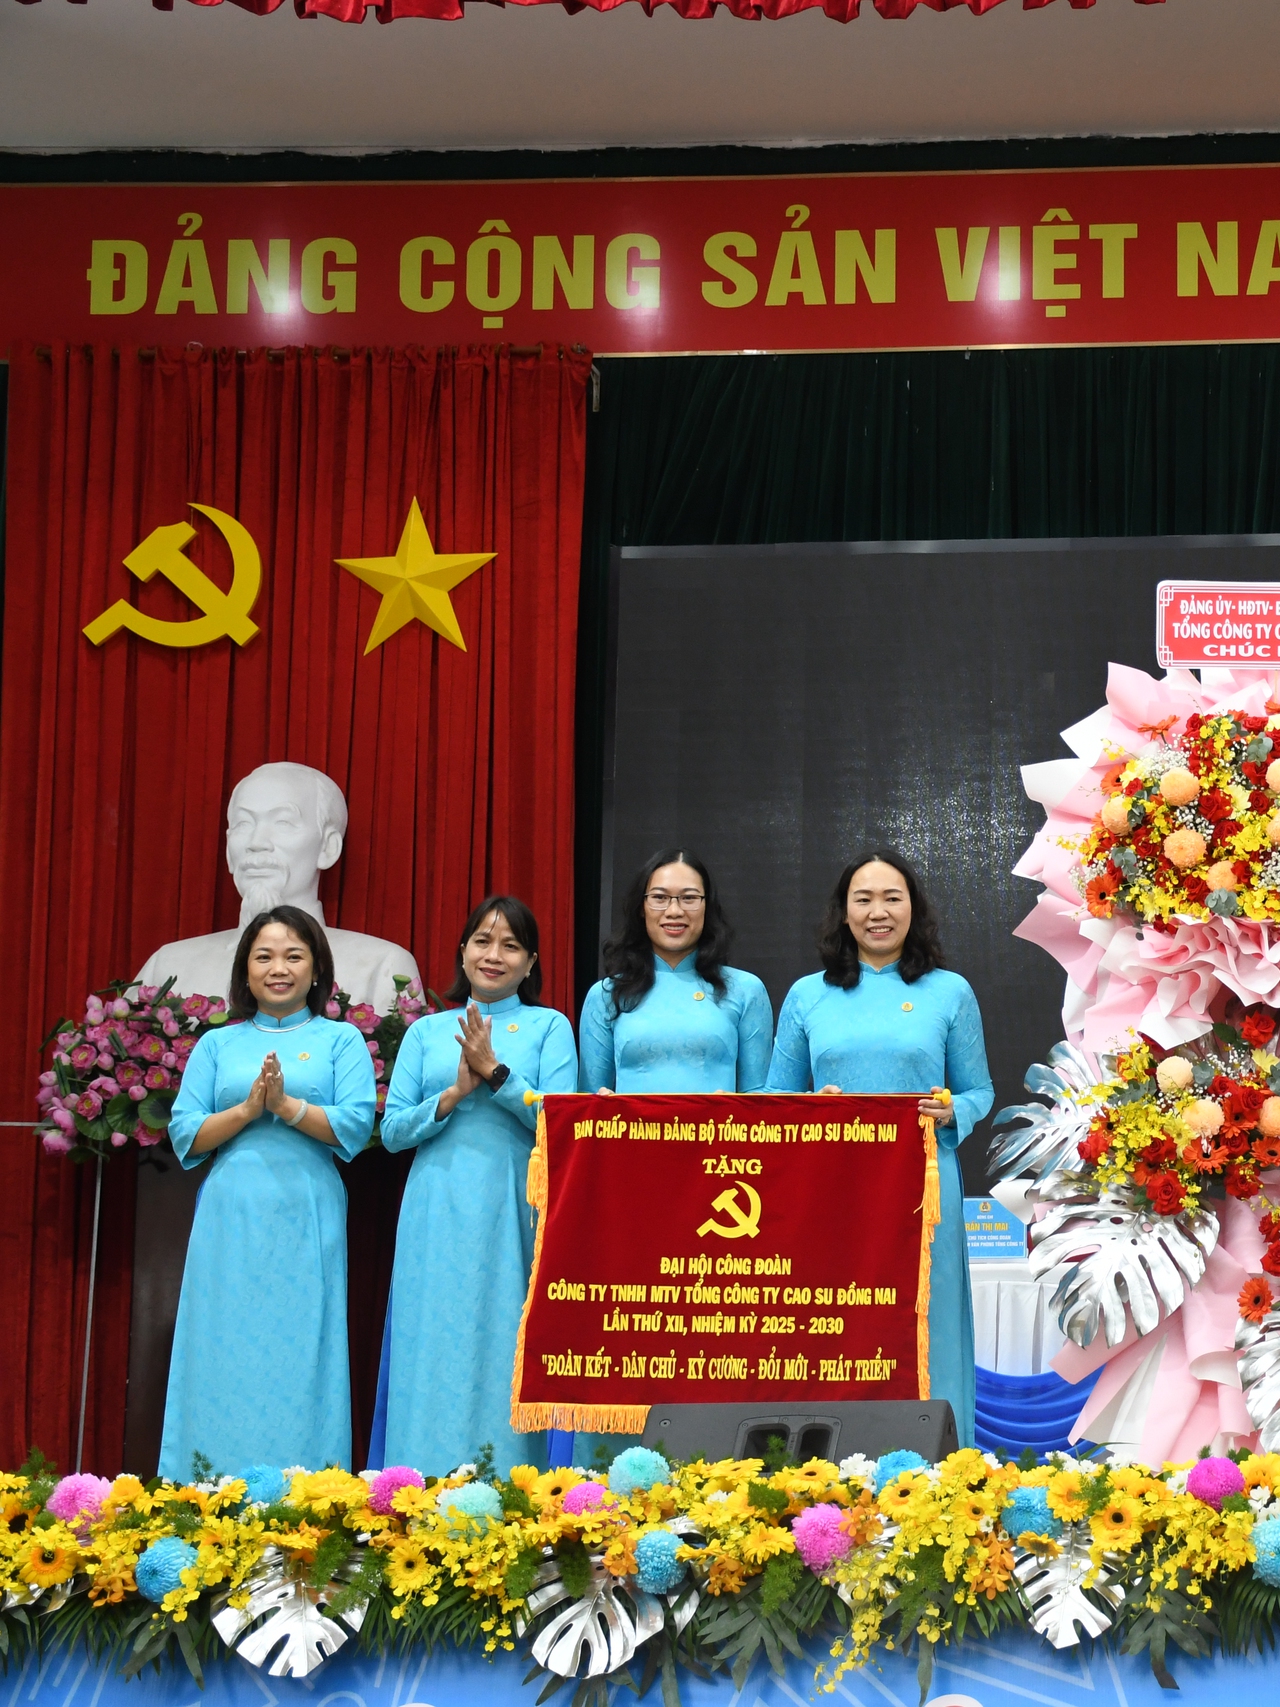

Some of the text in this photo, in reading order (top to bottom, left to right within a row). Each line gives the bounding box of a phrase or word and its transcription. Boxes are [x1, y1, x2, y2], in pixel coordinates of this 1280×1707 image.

[86, 212, 357, 316] ĐẢNG
[399, 219, 661, 329] CỘNG
[701, 204, 897, 308] SẢN
[935, 207, 1138, 318] VIỆT
[1180, 594, 1213, 615] ĐẢNG
[1215, 594, 1236, 615] ỦY-
[1238, 600, 1273, 615] HĐTV-
[1172, 615, 1211, 639] TỔNG
[1213, 618, 1253, 639] CÔNG
[1255, 623, 1272, 639] TY
[1203, 642, 1271, 657] CHÚC
[574, 1114, 897, 1145] BAN CHẤP HÀNH ĐẢNG BỘ TỔNG CÔNG TY CAO SU ĐỒNG NAI
[702, 1154, 763, 1177] TẶNG
[660, 1253, 792, 1278] ĐẠI HỘI CÔNG ĐOÀN
[547, 1278, 896, 1305] CÔNG TY TNHH MTV TỔNG CÔNG TY CAO SU ĐỒNG NAI
[603, 1306, 629, 1331] LẦN
[632, 1310, 663, 1332] THỨ
[665, 1315, 688, 1336] XII,
[691, 1311, 736, 1336] NHIỆM
[739, 1311, 758, 1333] KỲ
[760, 1316, 796, 1334] 2025
[808, 1317, 844, 1335] 2030
[542, 1348, 582, 1377] "ĐOÀN
[585, 1346, 612, 1378] KẾT
[622, 1350, 647, 1378] DÂN
[650, 1349, 677, 1379] CHỦ
[687, 1350, 706, 1379] KỶ
[709, 1354, 748, 1380] CƯƠNG
[758, 1346, 781, 1380] ĐỔI
[783, 1353, 809, 1381] MỚI
[819, 1354, 852, 1381] PHÁT
[855, 1347, 897, 1381] TRIỂN"
